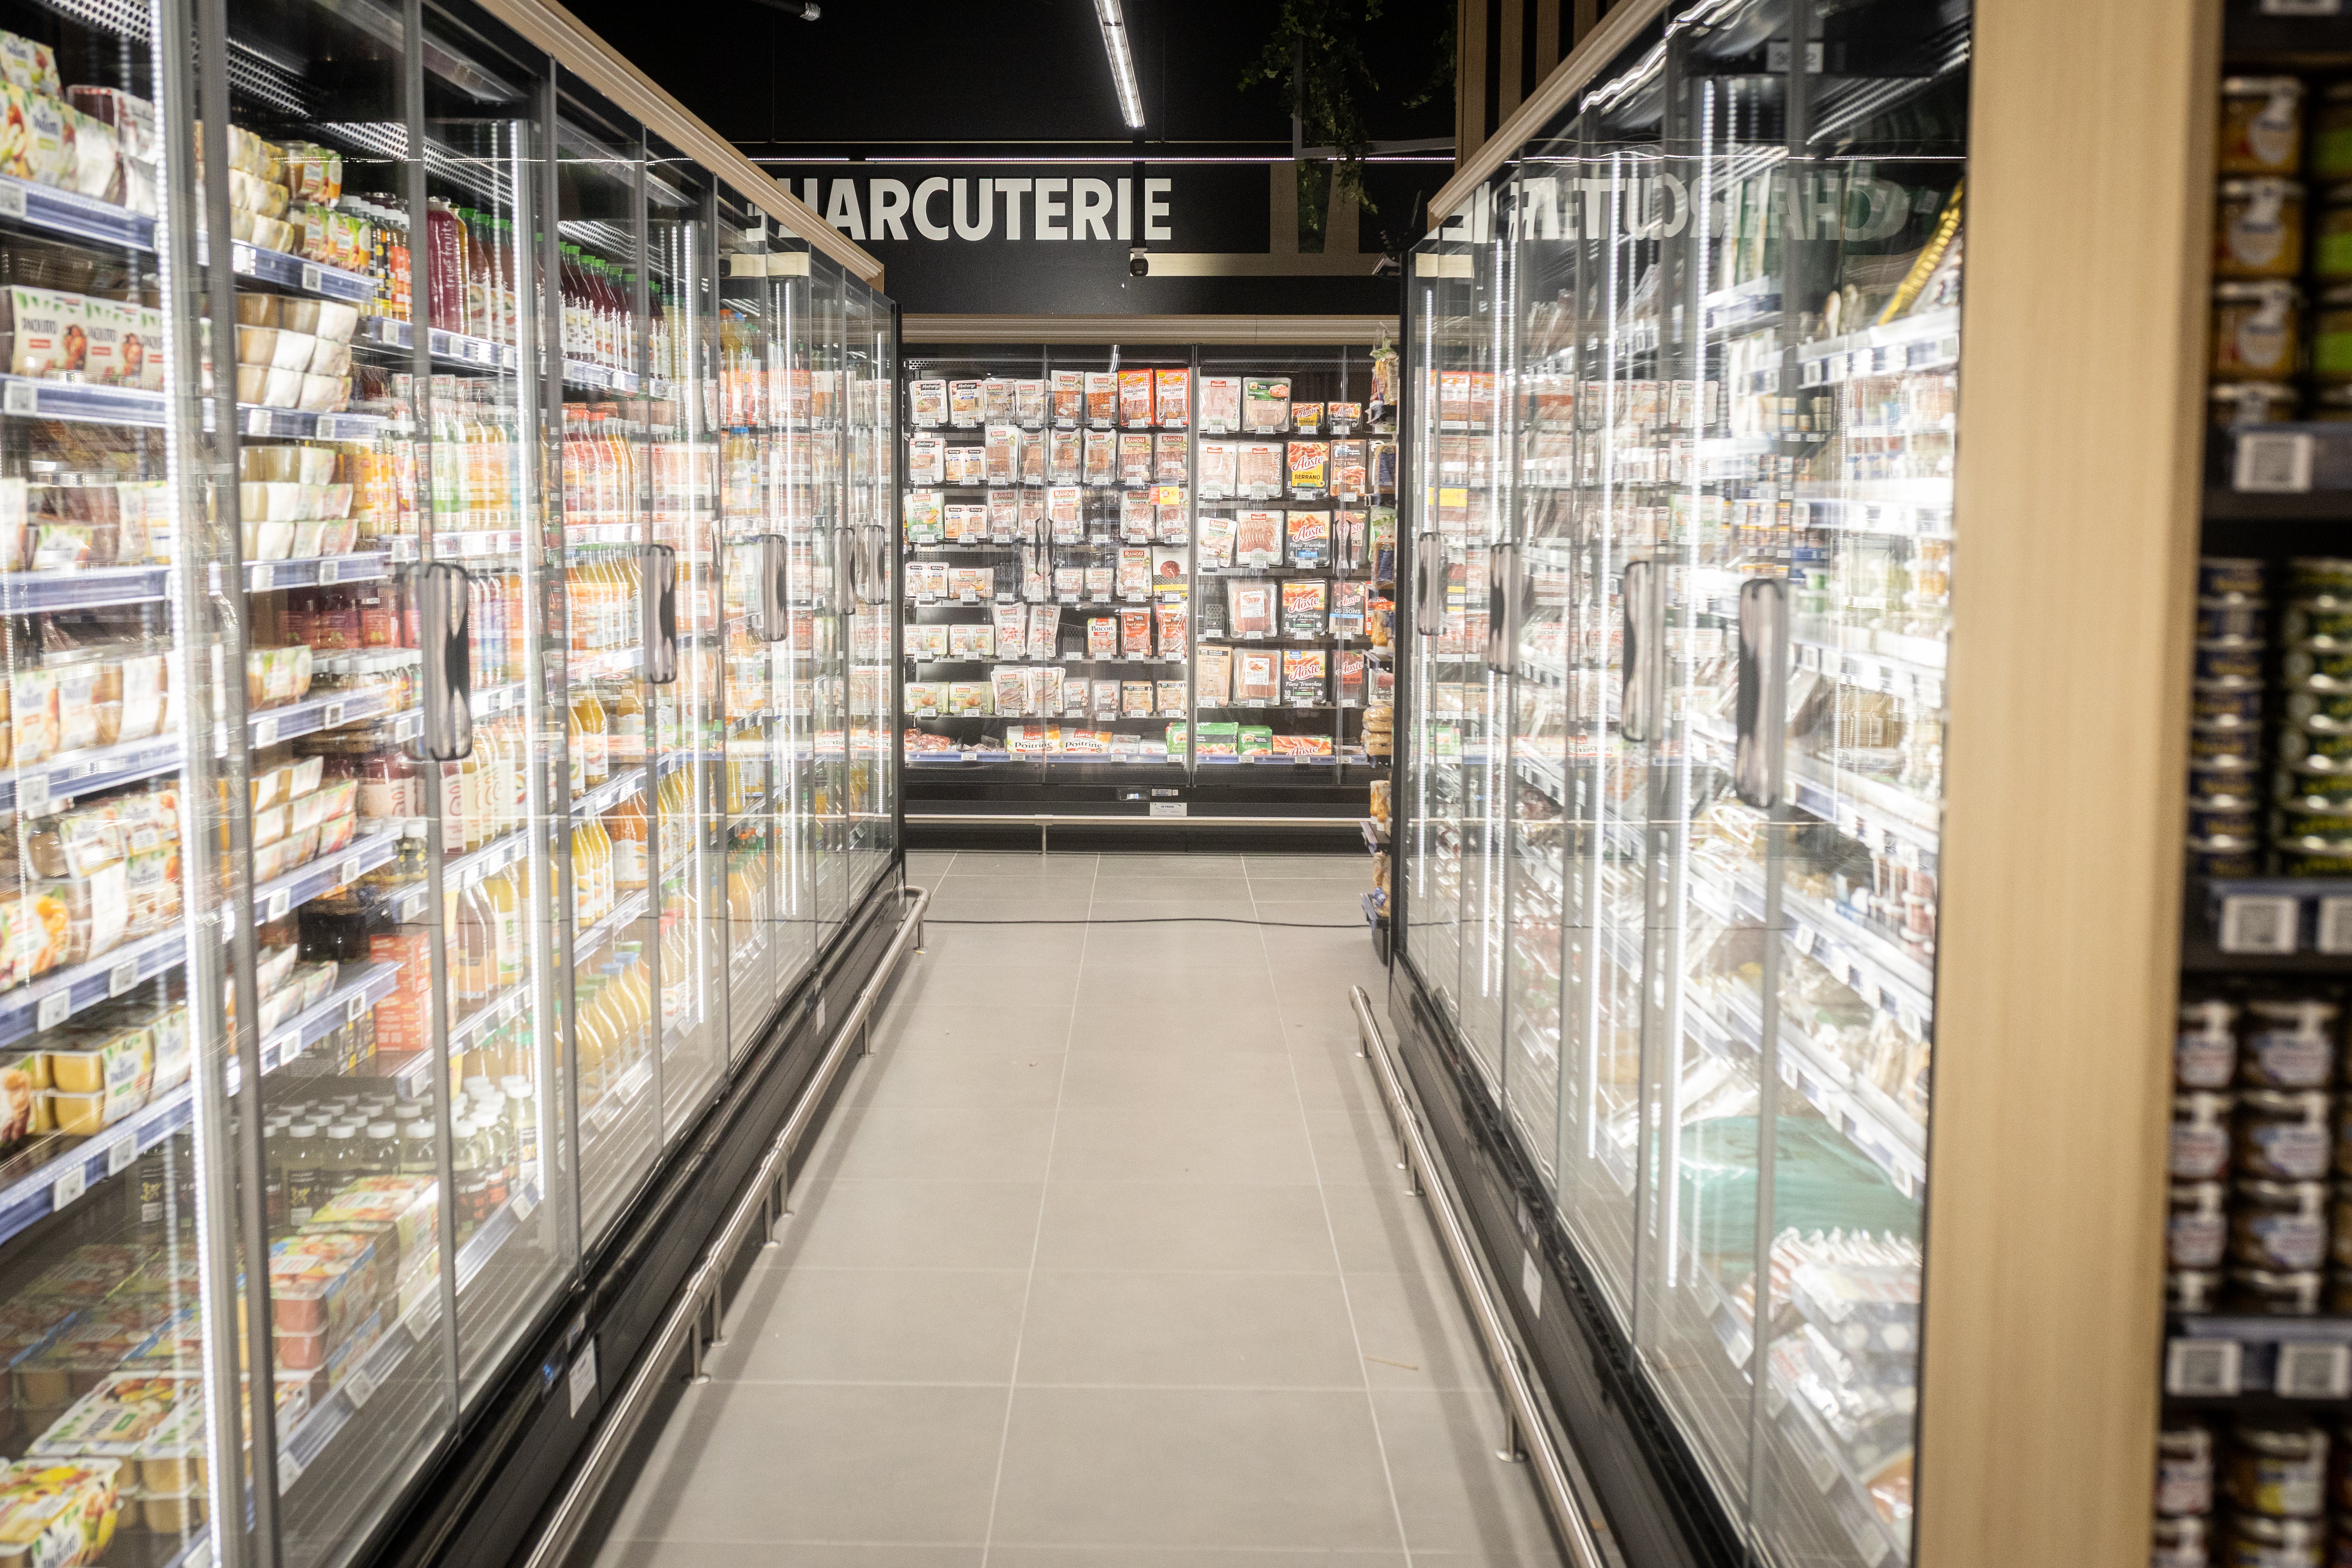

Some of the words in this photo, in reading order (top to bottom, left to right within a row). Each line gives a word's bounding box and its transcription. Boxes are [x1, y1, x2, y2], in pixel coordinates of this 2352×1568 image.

[777, 178, 1171, 240] ARCUTERIE
[1297, 407, 1317, 418] Aoste
[1291, 455, 1324, 472] Aoste
[1293, 525, 1324, 542] Aoste
[1288, 597, 1320, 613] Aoste
[1289, 665, 1320, 681] Aoste
[1286, 746, 1319, 755] Aoste
